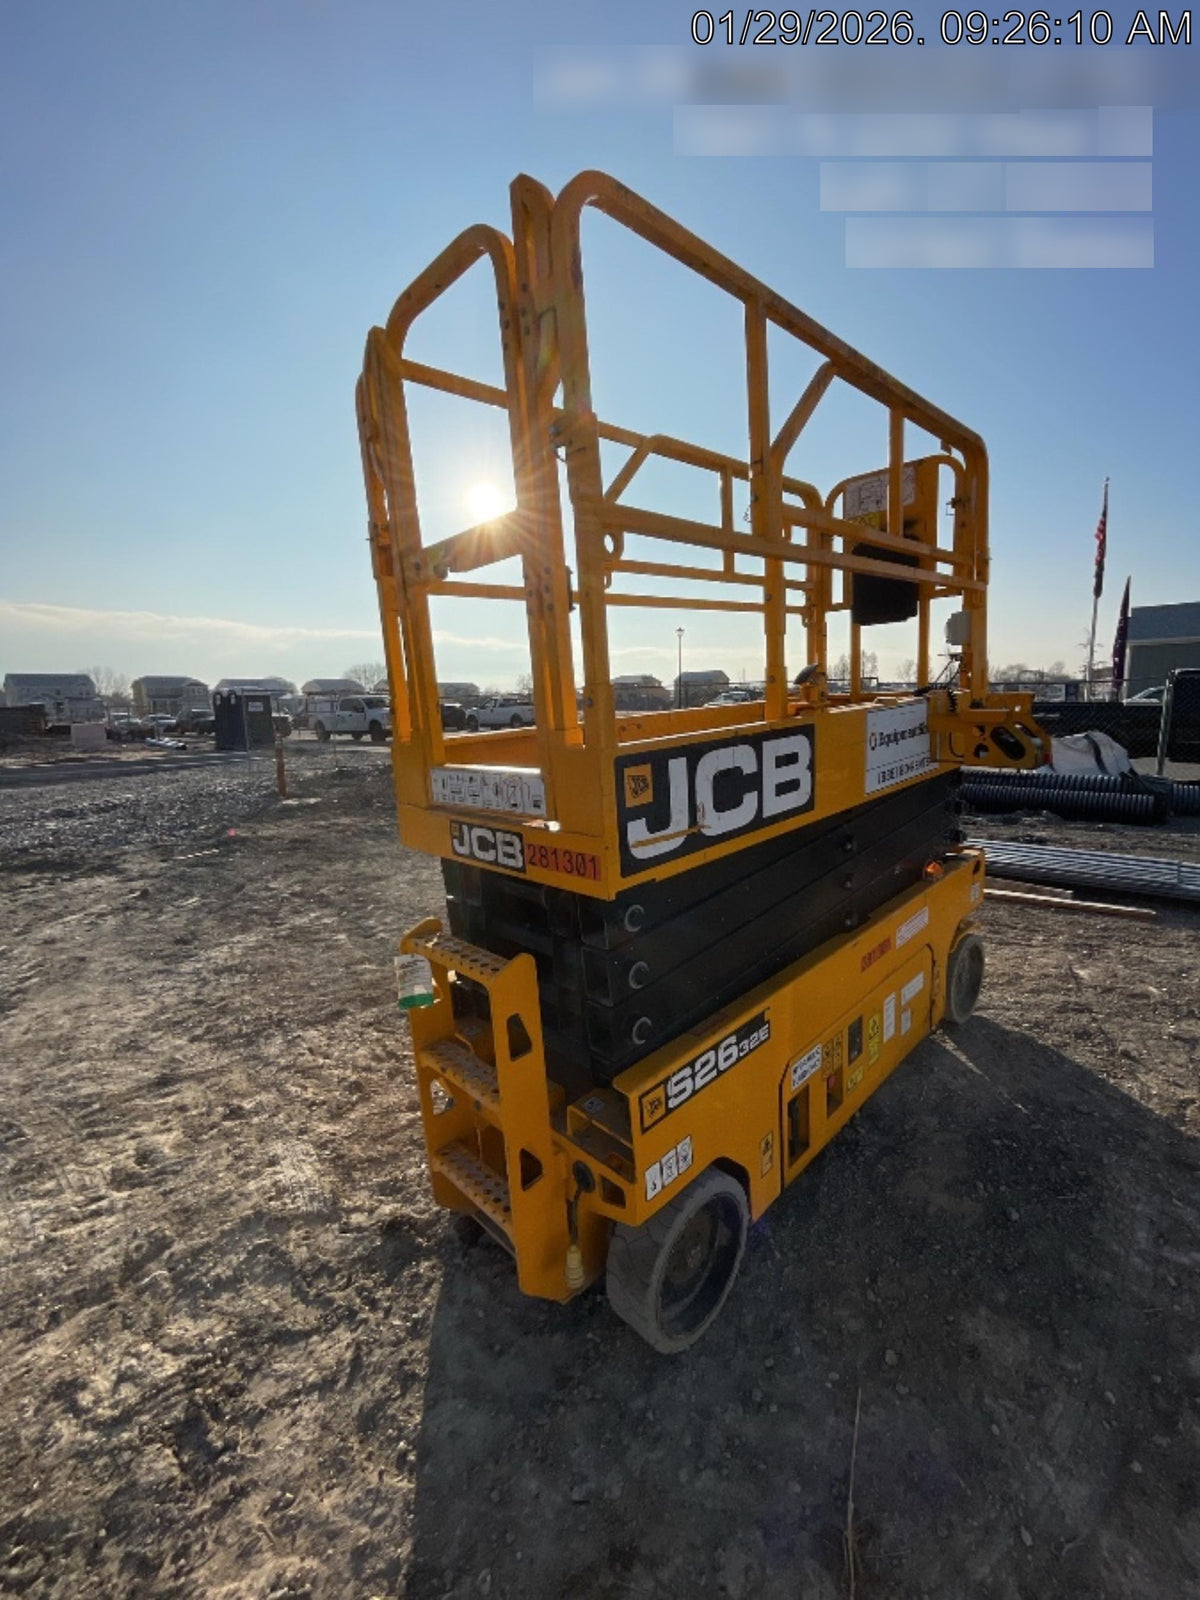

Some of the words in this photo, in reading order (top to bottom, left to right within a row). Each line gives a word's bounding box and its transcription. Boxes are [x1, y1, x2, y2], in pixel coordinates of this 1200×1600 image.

[626, 734, 811, 861] JCB
[452, 823, 524, 869] JCB
[527, 843, 599, 881] 281301
[666, 1035, 739, 1109] S26
